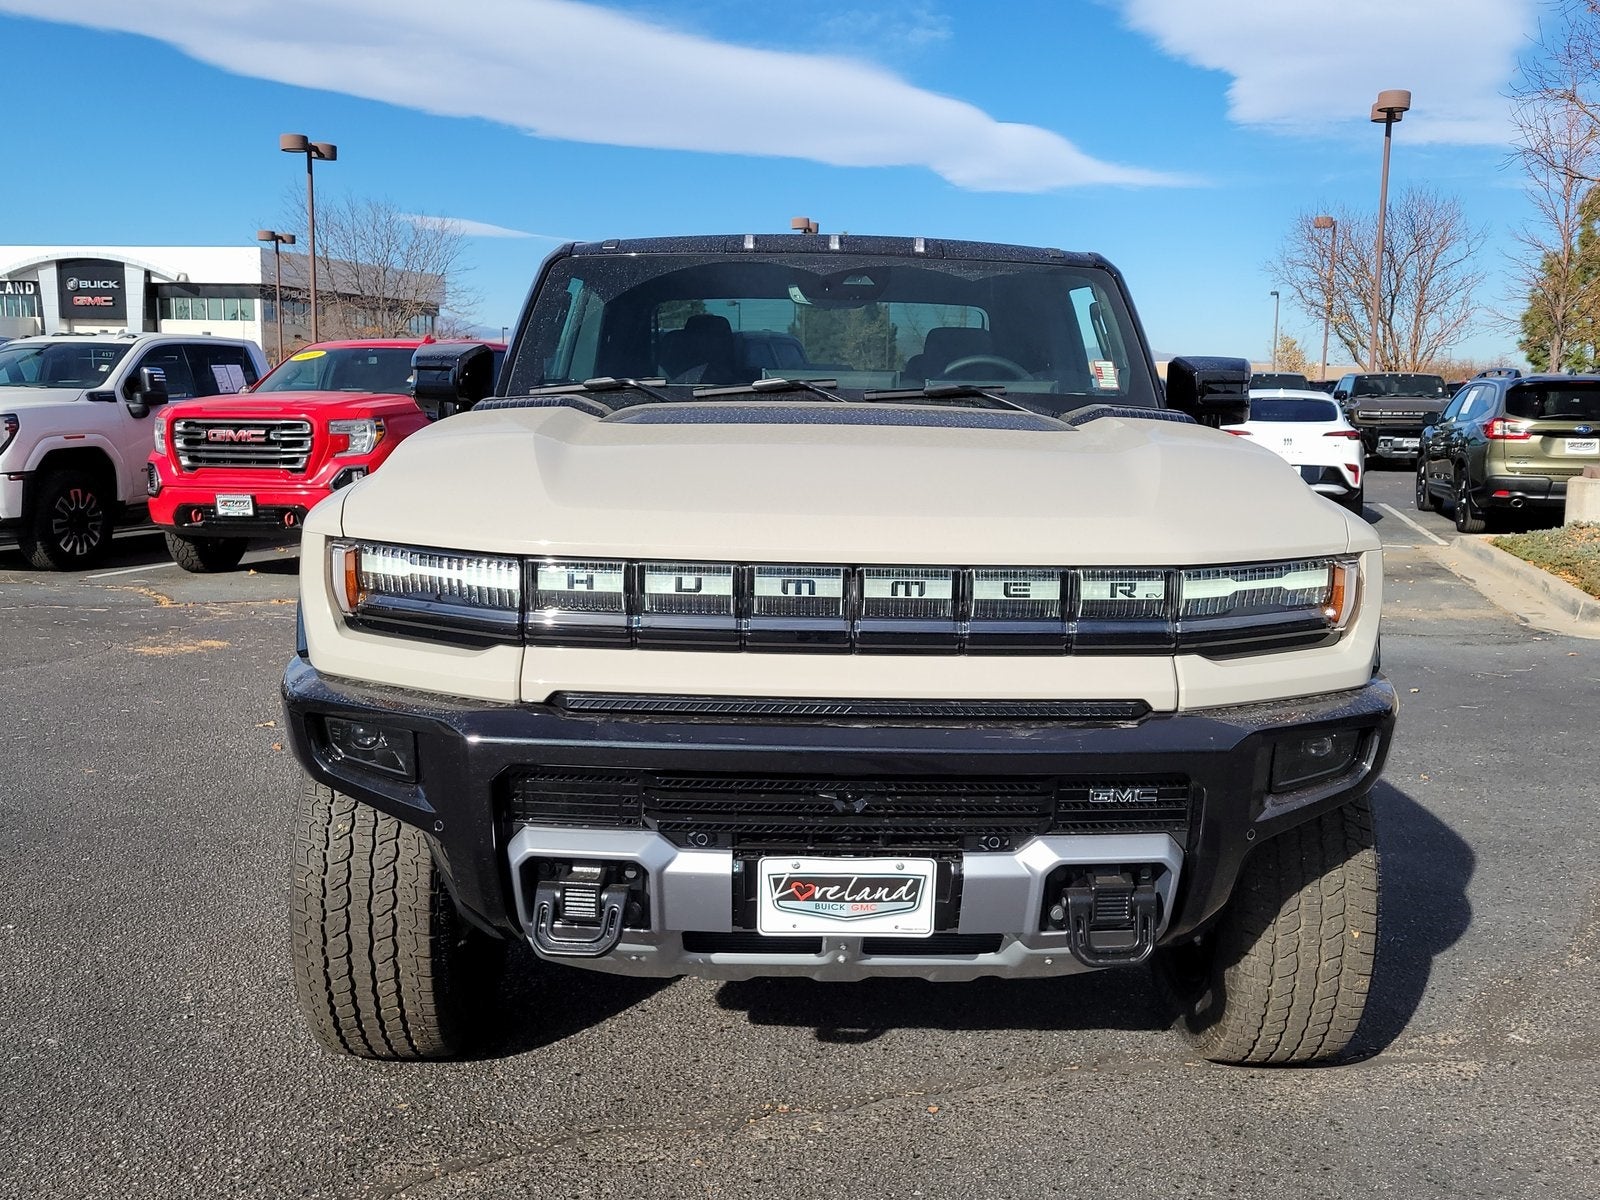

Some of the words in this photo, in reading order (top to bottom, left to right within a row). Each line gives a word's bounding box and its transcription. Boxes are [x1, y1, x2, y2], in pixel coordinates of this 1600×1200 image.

[79, 280, 120, 289] BUICK
[73, 296, 113, 306] GMC
[207, 429, 266, 442] GMC
[1089, 788, 1158, 803] GMC
[814, 903, 846, 911] BUICK
[851, 903, 878, 912] GMC
